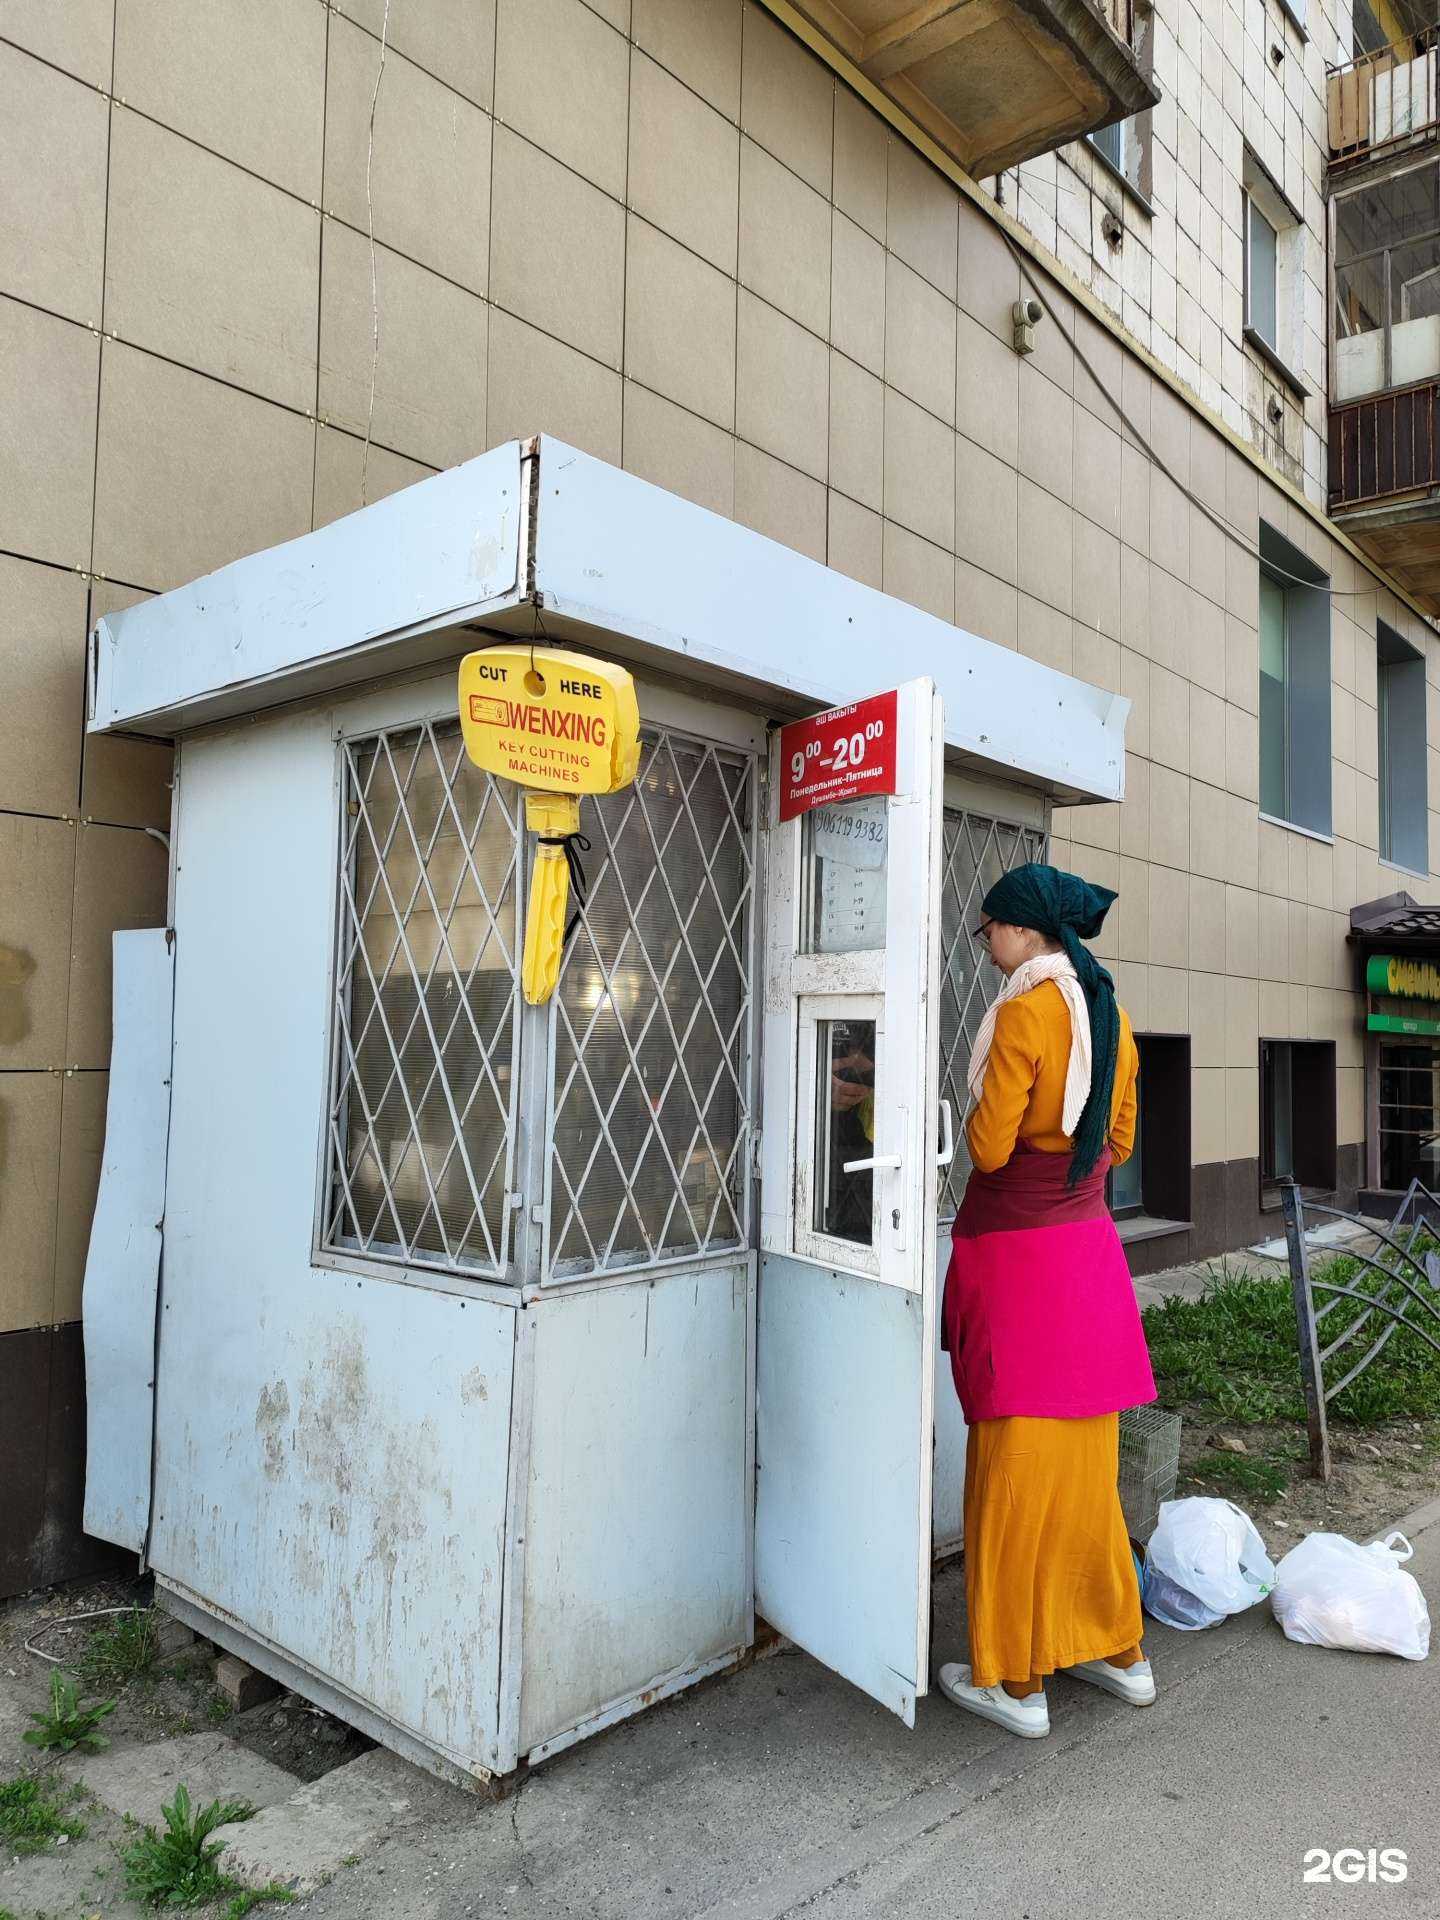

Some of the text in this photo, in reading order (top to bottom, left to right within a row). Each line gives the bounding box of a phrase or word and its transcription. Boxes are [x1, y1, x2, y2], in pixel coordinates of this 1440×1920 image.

[479, 665, 603, 699] CUT HERE
[508, 701, 606, 747] WENXING
[498, 739, 591, 768] KEY CUTTING
[508, 758, 580, 783] MACHINES
[854, 818, 884, 843] 9382
